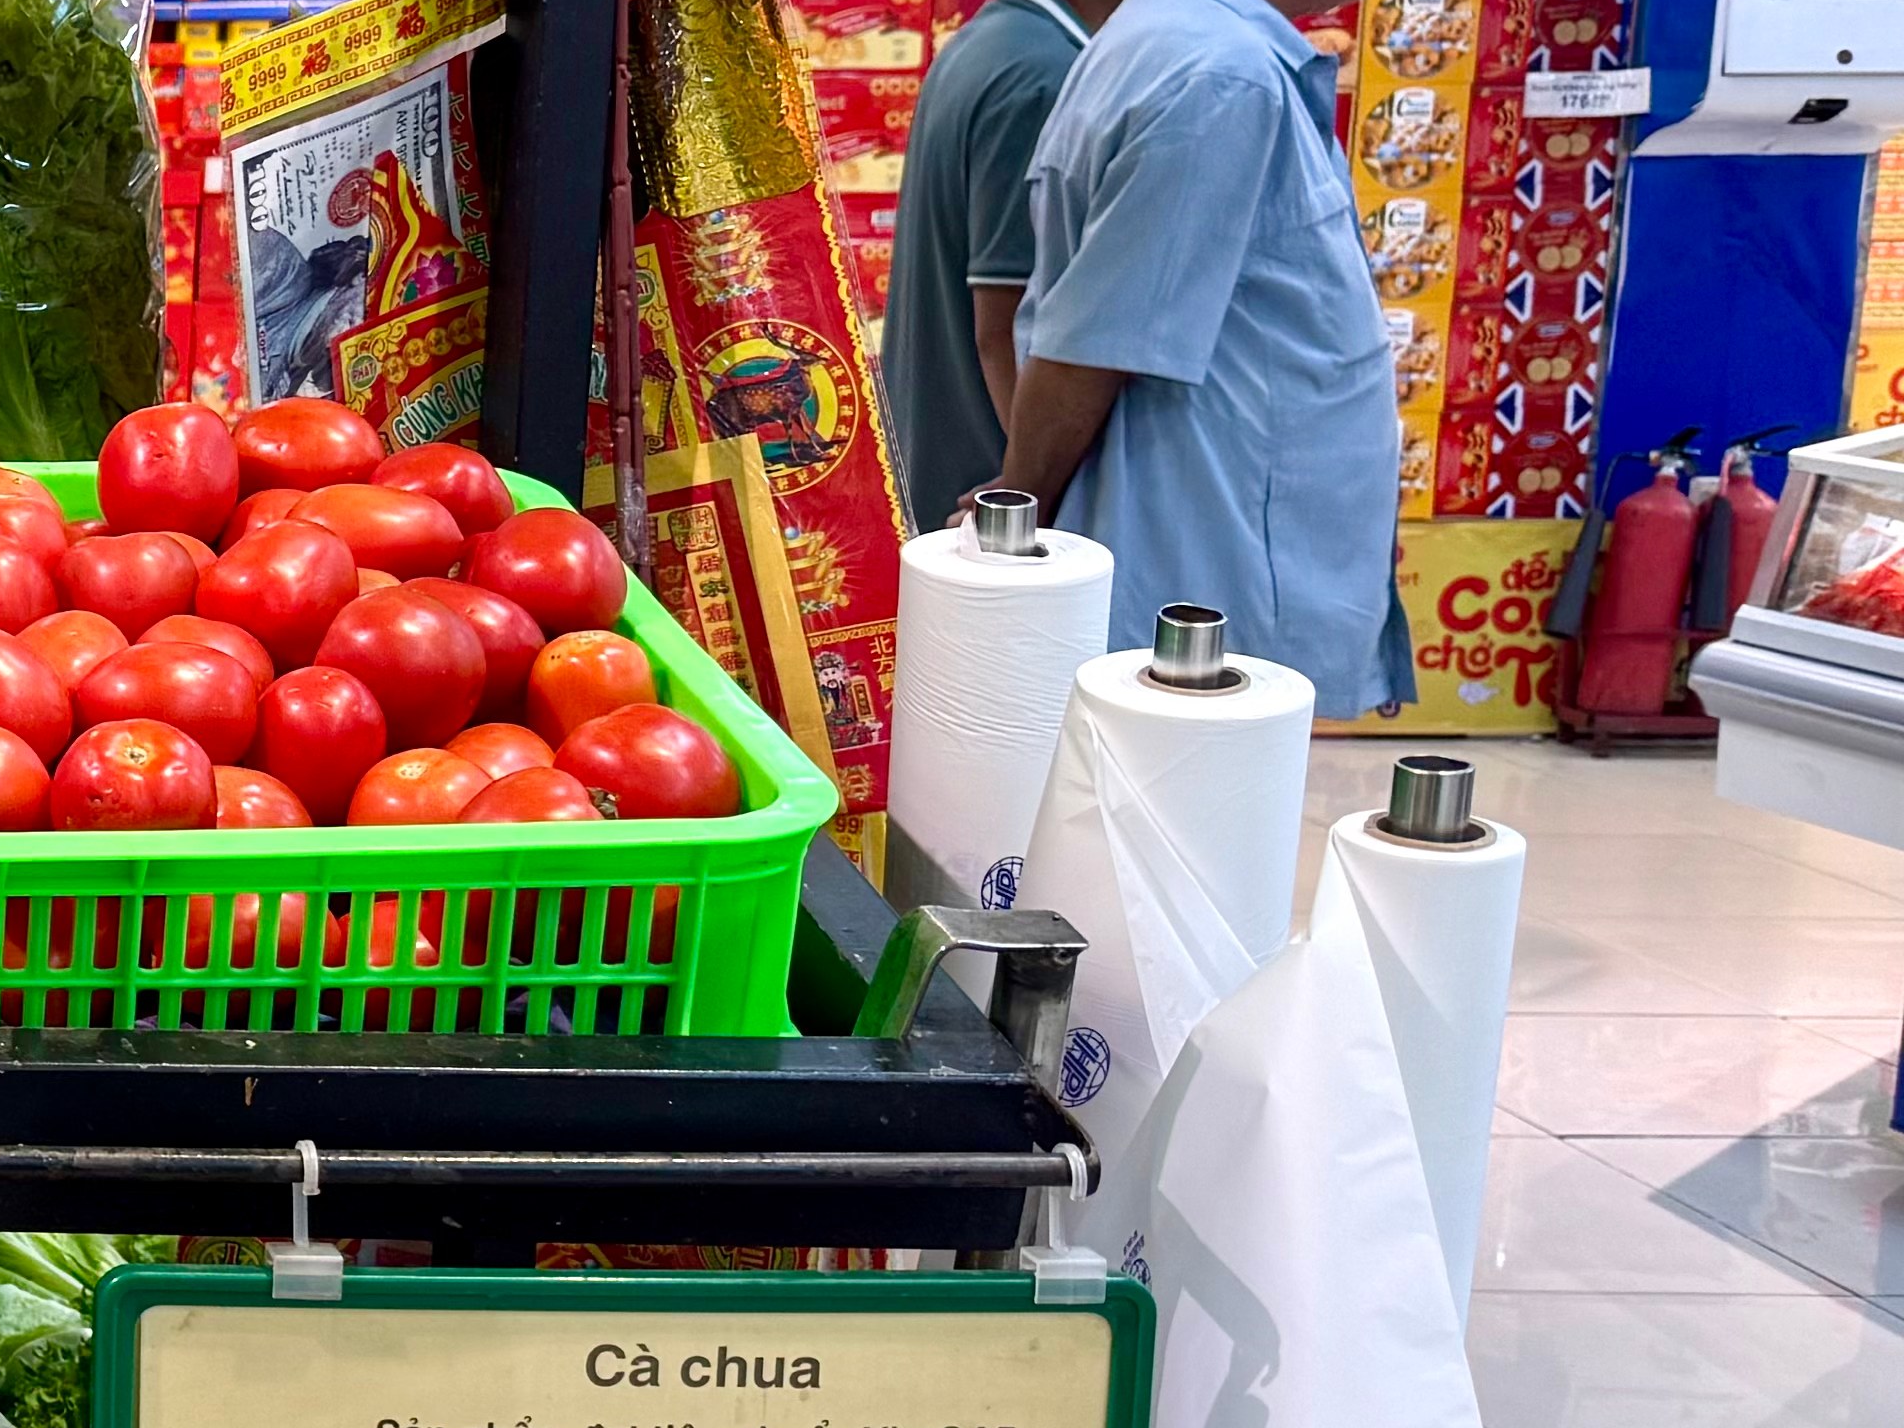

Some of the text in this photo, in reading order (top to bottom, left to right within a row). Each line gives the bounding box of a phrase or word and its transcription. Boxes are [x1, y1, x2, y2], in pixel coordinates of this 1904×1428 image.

[248, 62, 287, 92] 9999
[301, 38, 332, 78] 福
[343, 25, 382, 54] 9999
[396, 0, 427, 41] 福
[248, 162, 270, 232] 100
[584, 1338, 823, 1390] Cà chua
